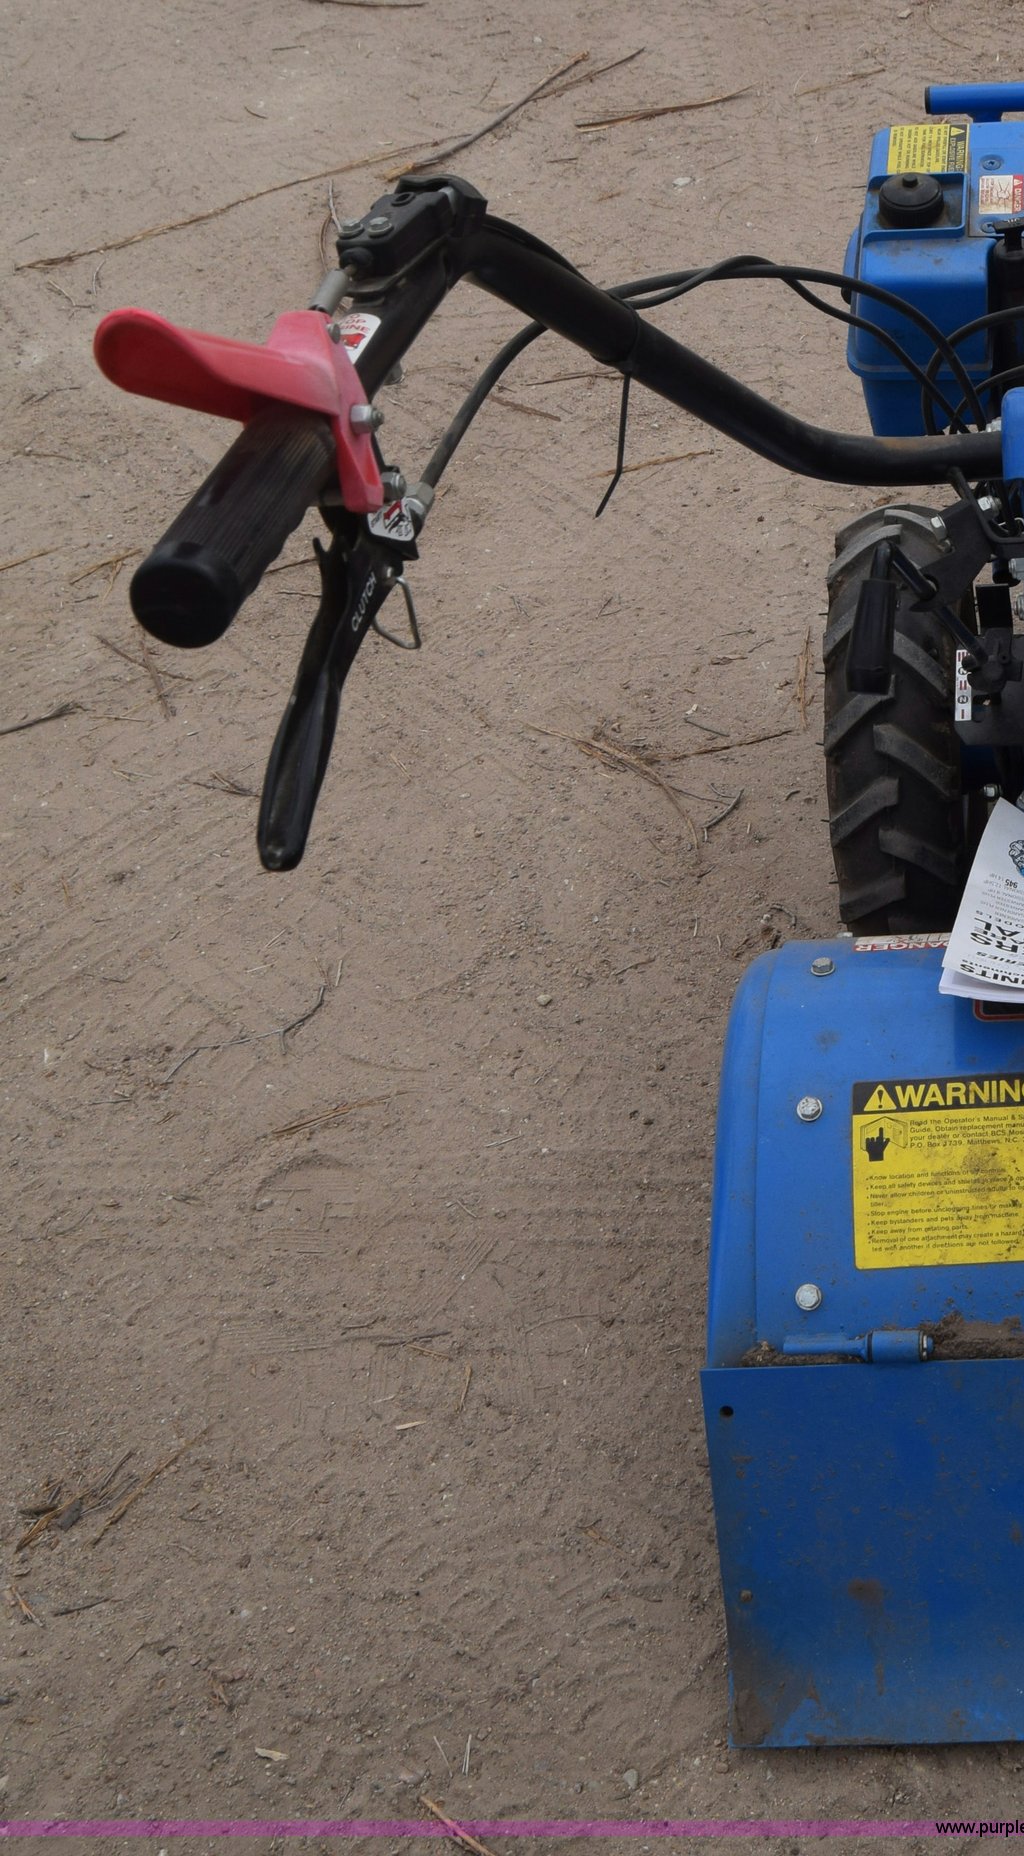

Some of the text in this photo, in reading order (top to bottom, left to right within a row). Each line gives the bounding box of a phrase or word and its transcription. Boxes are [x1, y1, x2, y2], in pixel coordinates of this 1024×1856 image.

[351, 571, 377, 633] CLUTCH
[1004, 878, 1018, 889] 945
[960, 1123, 1004, 1132] replacement
[910, 1134, 926, 1142] your
[961, 1131, 989, 1139] contact
[898, 1182, 916, 1190] safety
[921, 1234, 957, 1242] attachment
[932, 1241, 964, 1249] directions
